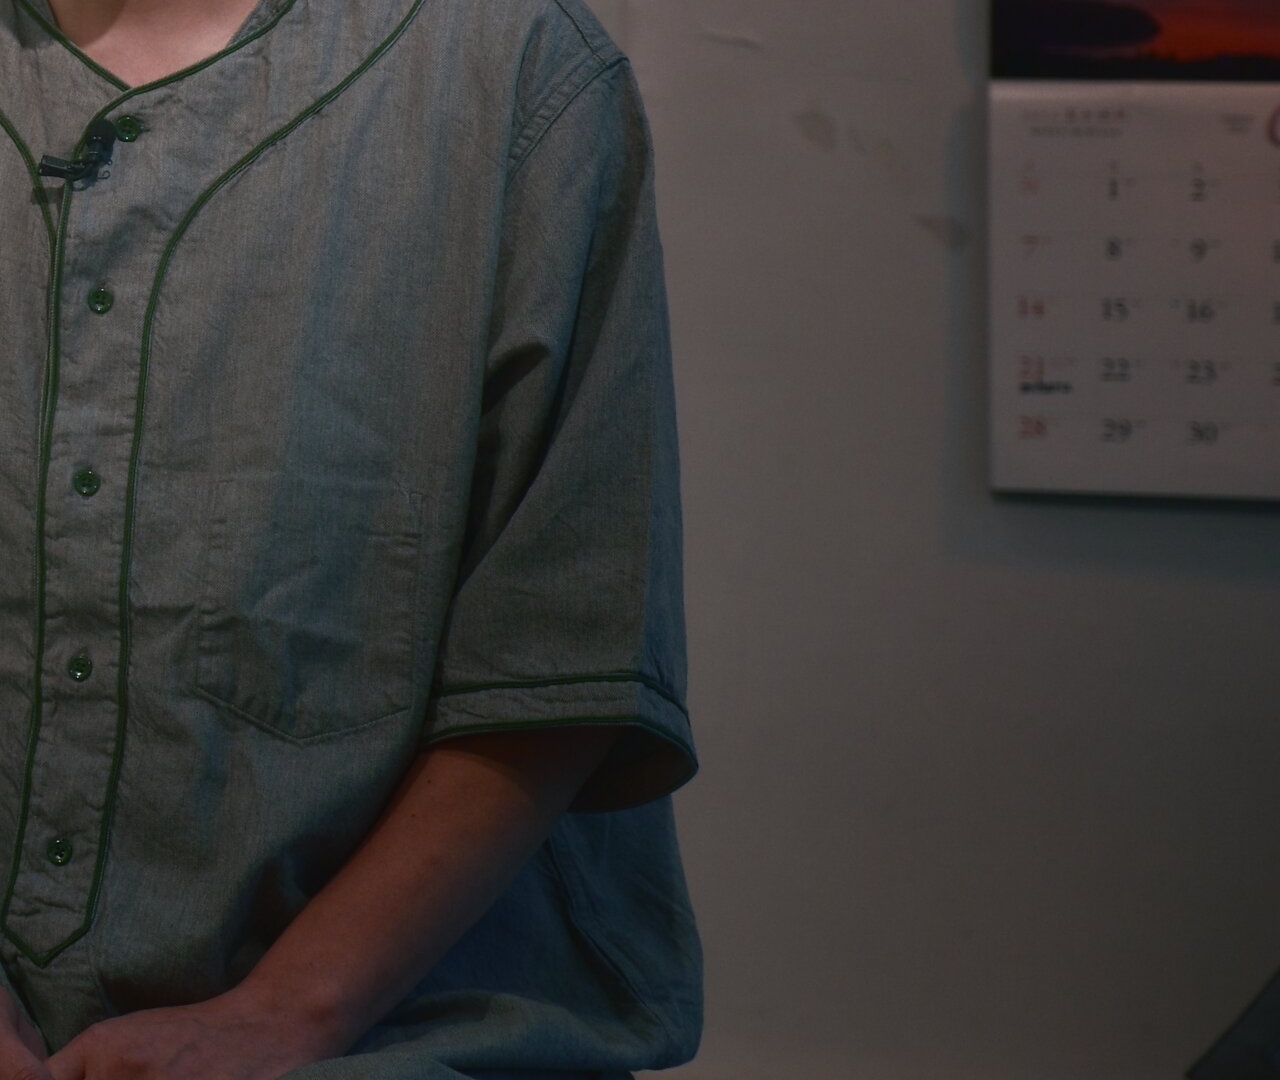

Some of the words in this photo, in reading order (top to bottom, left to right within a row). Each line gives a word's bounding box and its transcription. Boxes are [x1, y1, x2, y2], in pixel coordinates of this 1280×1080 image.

[1104, 236, 1121, 261] 8
[1191, 237, 1208, 263] 9
[1101, 296, 1129, 322] 15
[1187, 298, 1215, 324] 16
[1100, 356, 1130, 383] 22
[1186, 358, 1217, 385] 23
[1102, 417, 1133, 443] 29
[1188, 420, 1219, 446] 30
